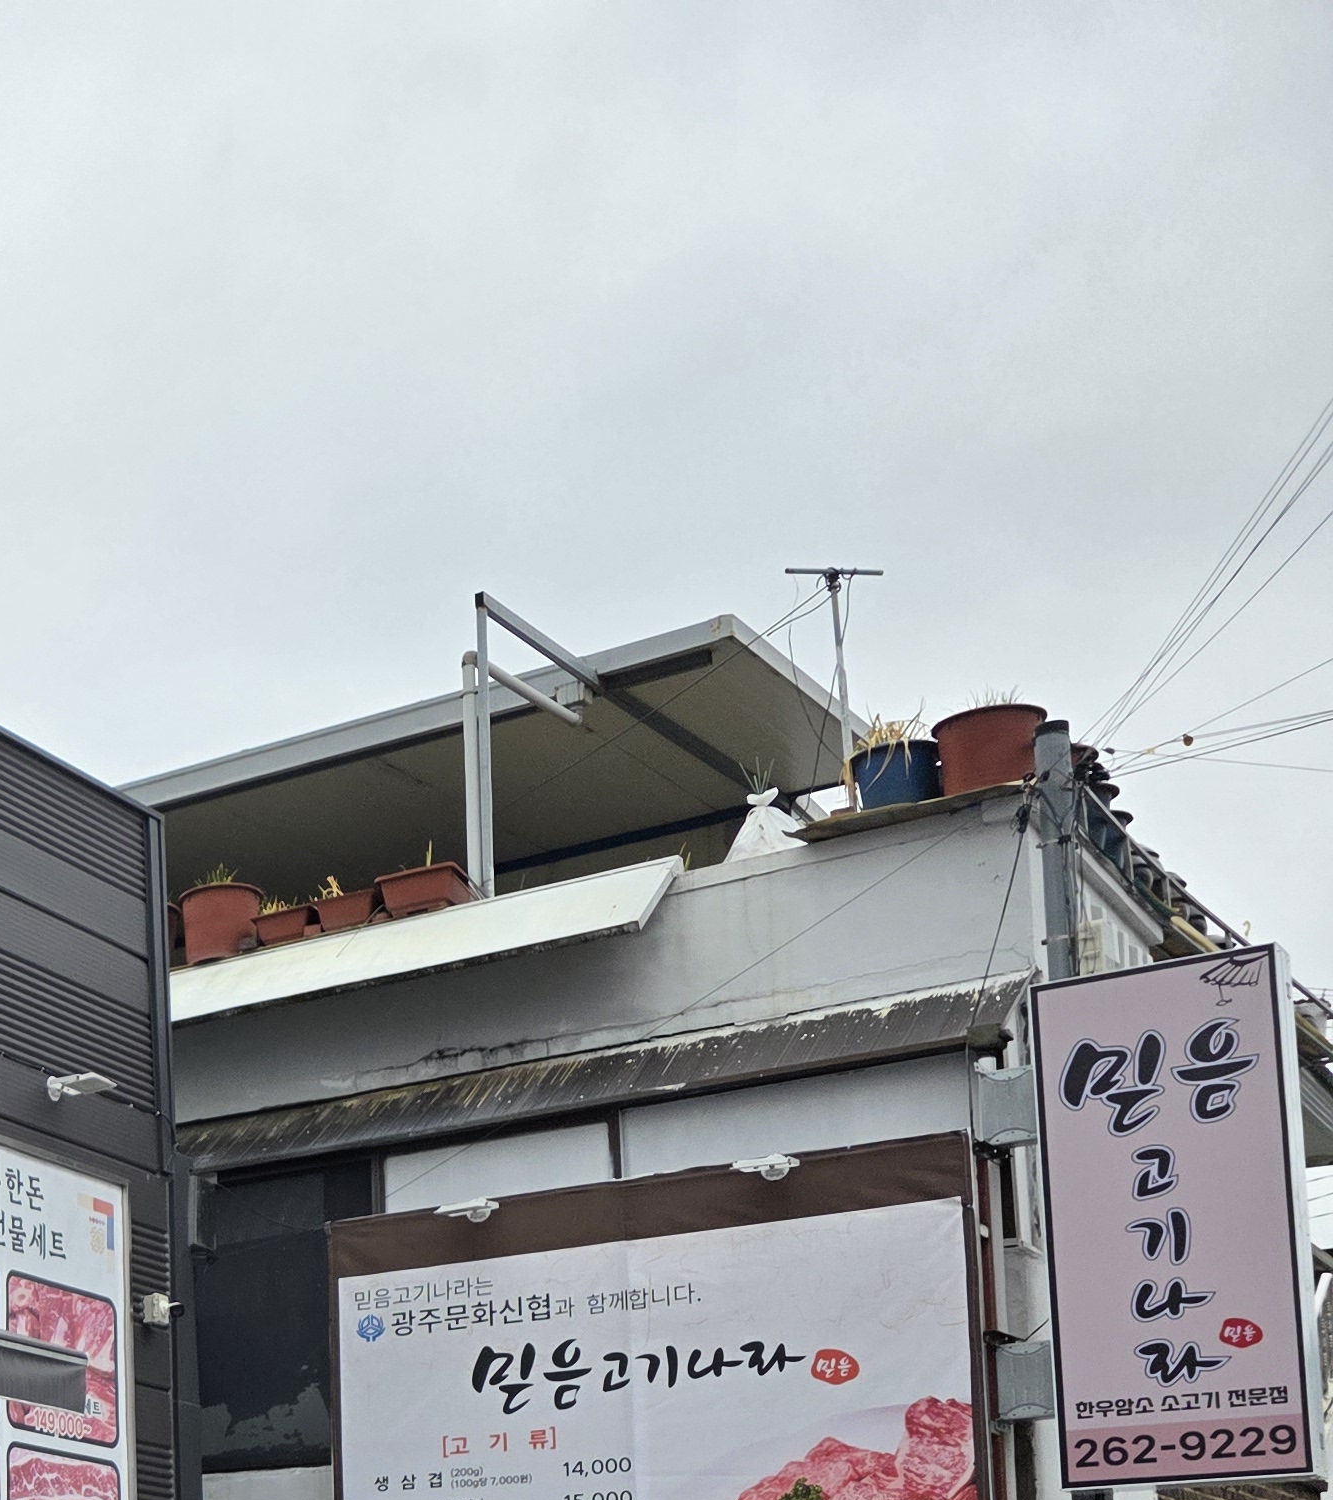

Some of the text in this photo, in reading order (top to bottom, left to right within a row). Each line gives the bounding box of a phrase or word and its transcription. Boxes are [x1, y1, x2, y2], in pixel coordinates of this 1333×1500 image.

[1060, 1018, 1259, 1136] 믿음
[354, 1276, 494, 1311] 믿음고기나라는
[391, 1282, 703, 1337] 광주문화신협과 함께합니다.
[471, 1338, 853, 1415] 믿음고기나라 믿음
[1075, 1385, 1289, 1419] 한우암소 소고기 전문점
[1073, 1423, 1297, 1469] 262-9229
[451, 1467, 483, 1478] (200g)
[563, 1457, 632, 1477] 14,000
